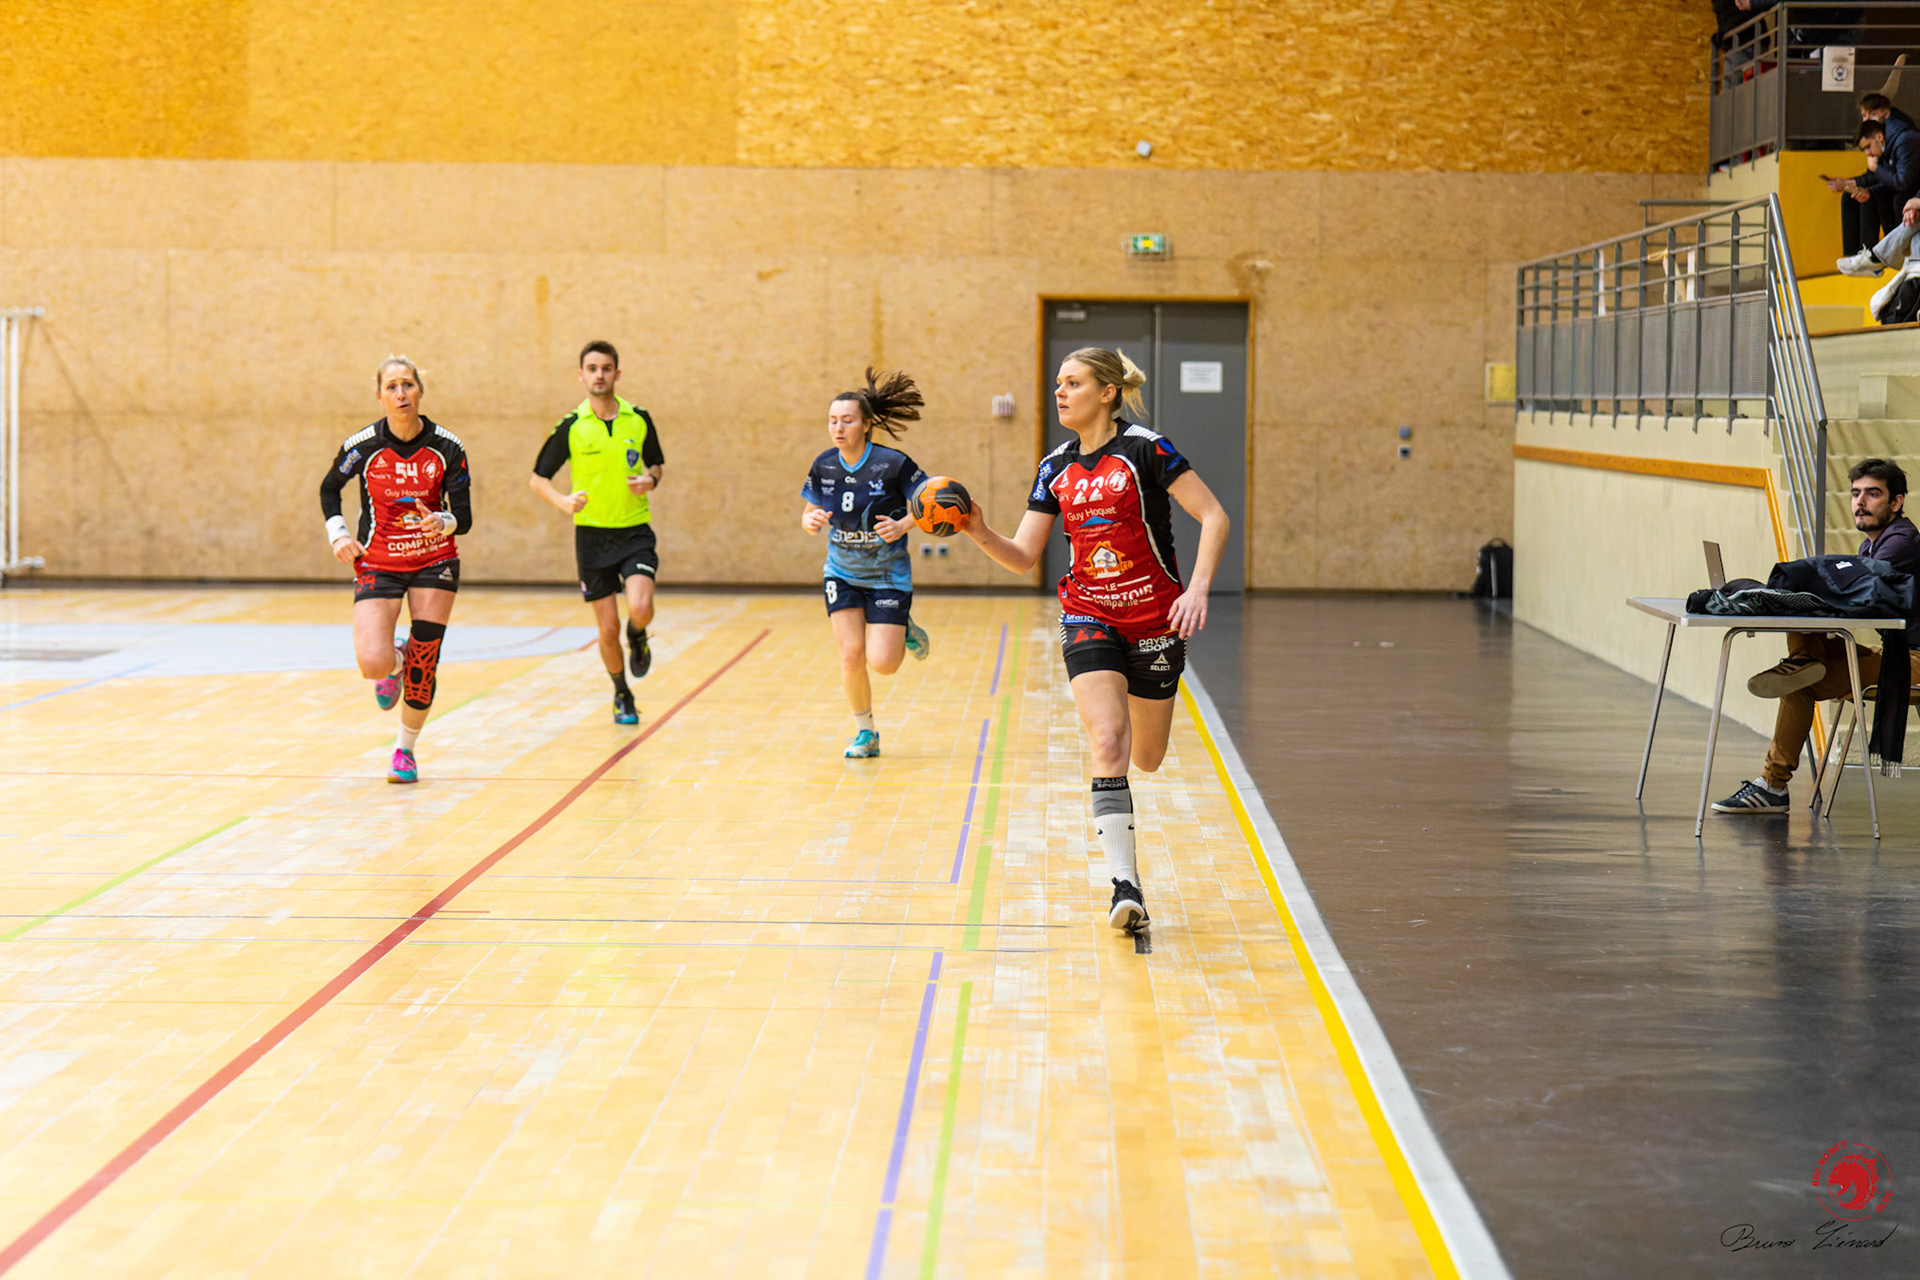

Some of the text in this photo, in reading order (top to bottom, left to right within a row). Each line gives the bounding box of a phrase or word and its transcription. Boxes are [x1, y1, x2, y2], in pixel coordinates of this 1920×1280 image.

[395, 462, 418, 484] 54
[384, 488, 429, 498] Guy Hoquet
[1072, 476, 1104, 505] 22
[841, 490, 855, 512] 8
[1066, 505, 1117, 522] Guy Hoquet
[412, 531, 423, 539] LE
[825, 580, 838, 604] 8
[1104, 582, 1117, 592] LE
[1138, 635, 1168, 647] PAYS
[1139, 640, 1176, 652] SPORT
